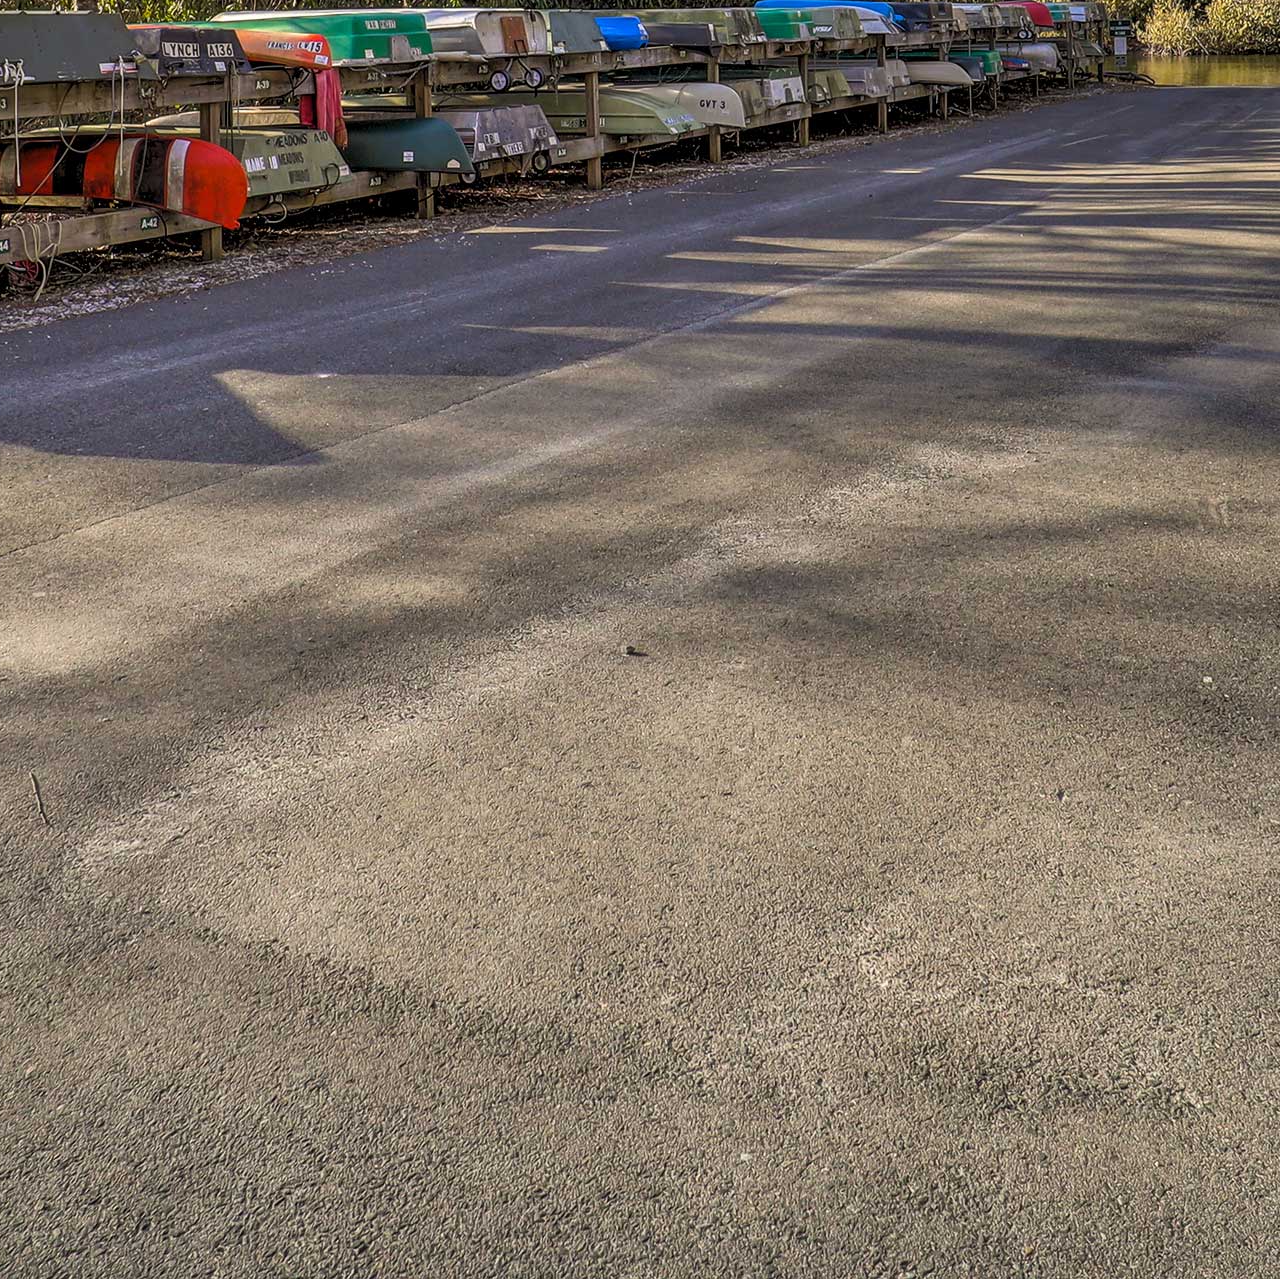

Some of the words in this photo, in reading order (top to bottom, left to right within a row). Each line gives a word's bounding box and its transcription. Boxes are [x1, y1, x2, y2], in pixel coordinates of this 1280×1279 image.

[162, 42, 200, 58] LYNCH
[207, 43, 234, 58] A136
[699, 99, 717, 109] GVT
[719, 100, 726, 109] 3
